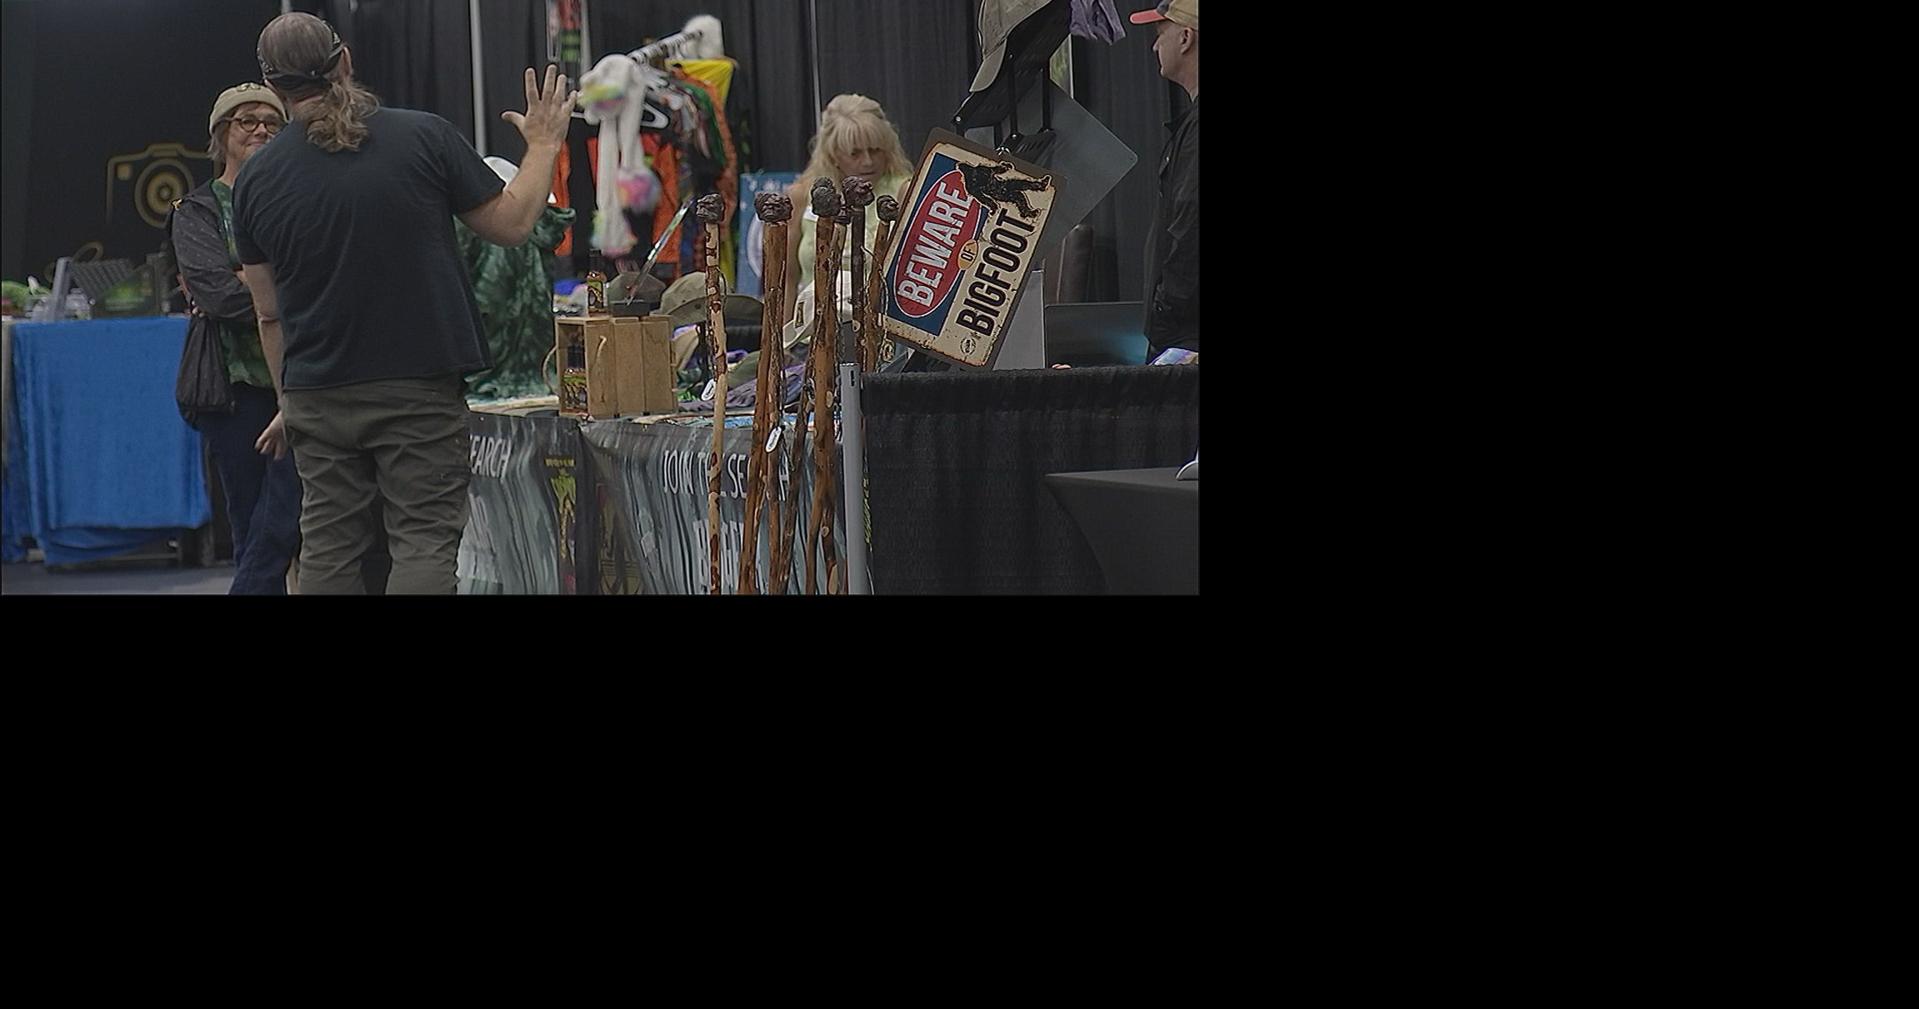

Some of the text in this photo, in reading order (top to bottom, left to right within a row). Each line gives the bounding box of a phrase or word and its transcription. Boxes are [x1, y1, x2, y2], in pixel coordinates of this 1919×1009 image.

[896, 182, 974, 307] BEWARE
[960, 244, 976, 262] OF
[956, 208, 1035, 337] BIGFOOT
[469, 433, 512, 482] EARCH
[663, 449, 789, 502] JOIN TH SEH
